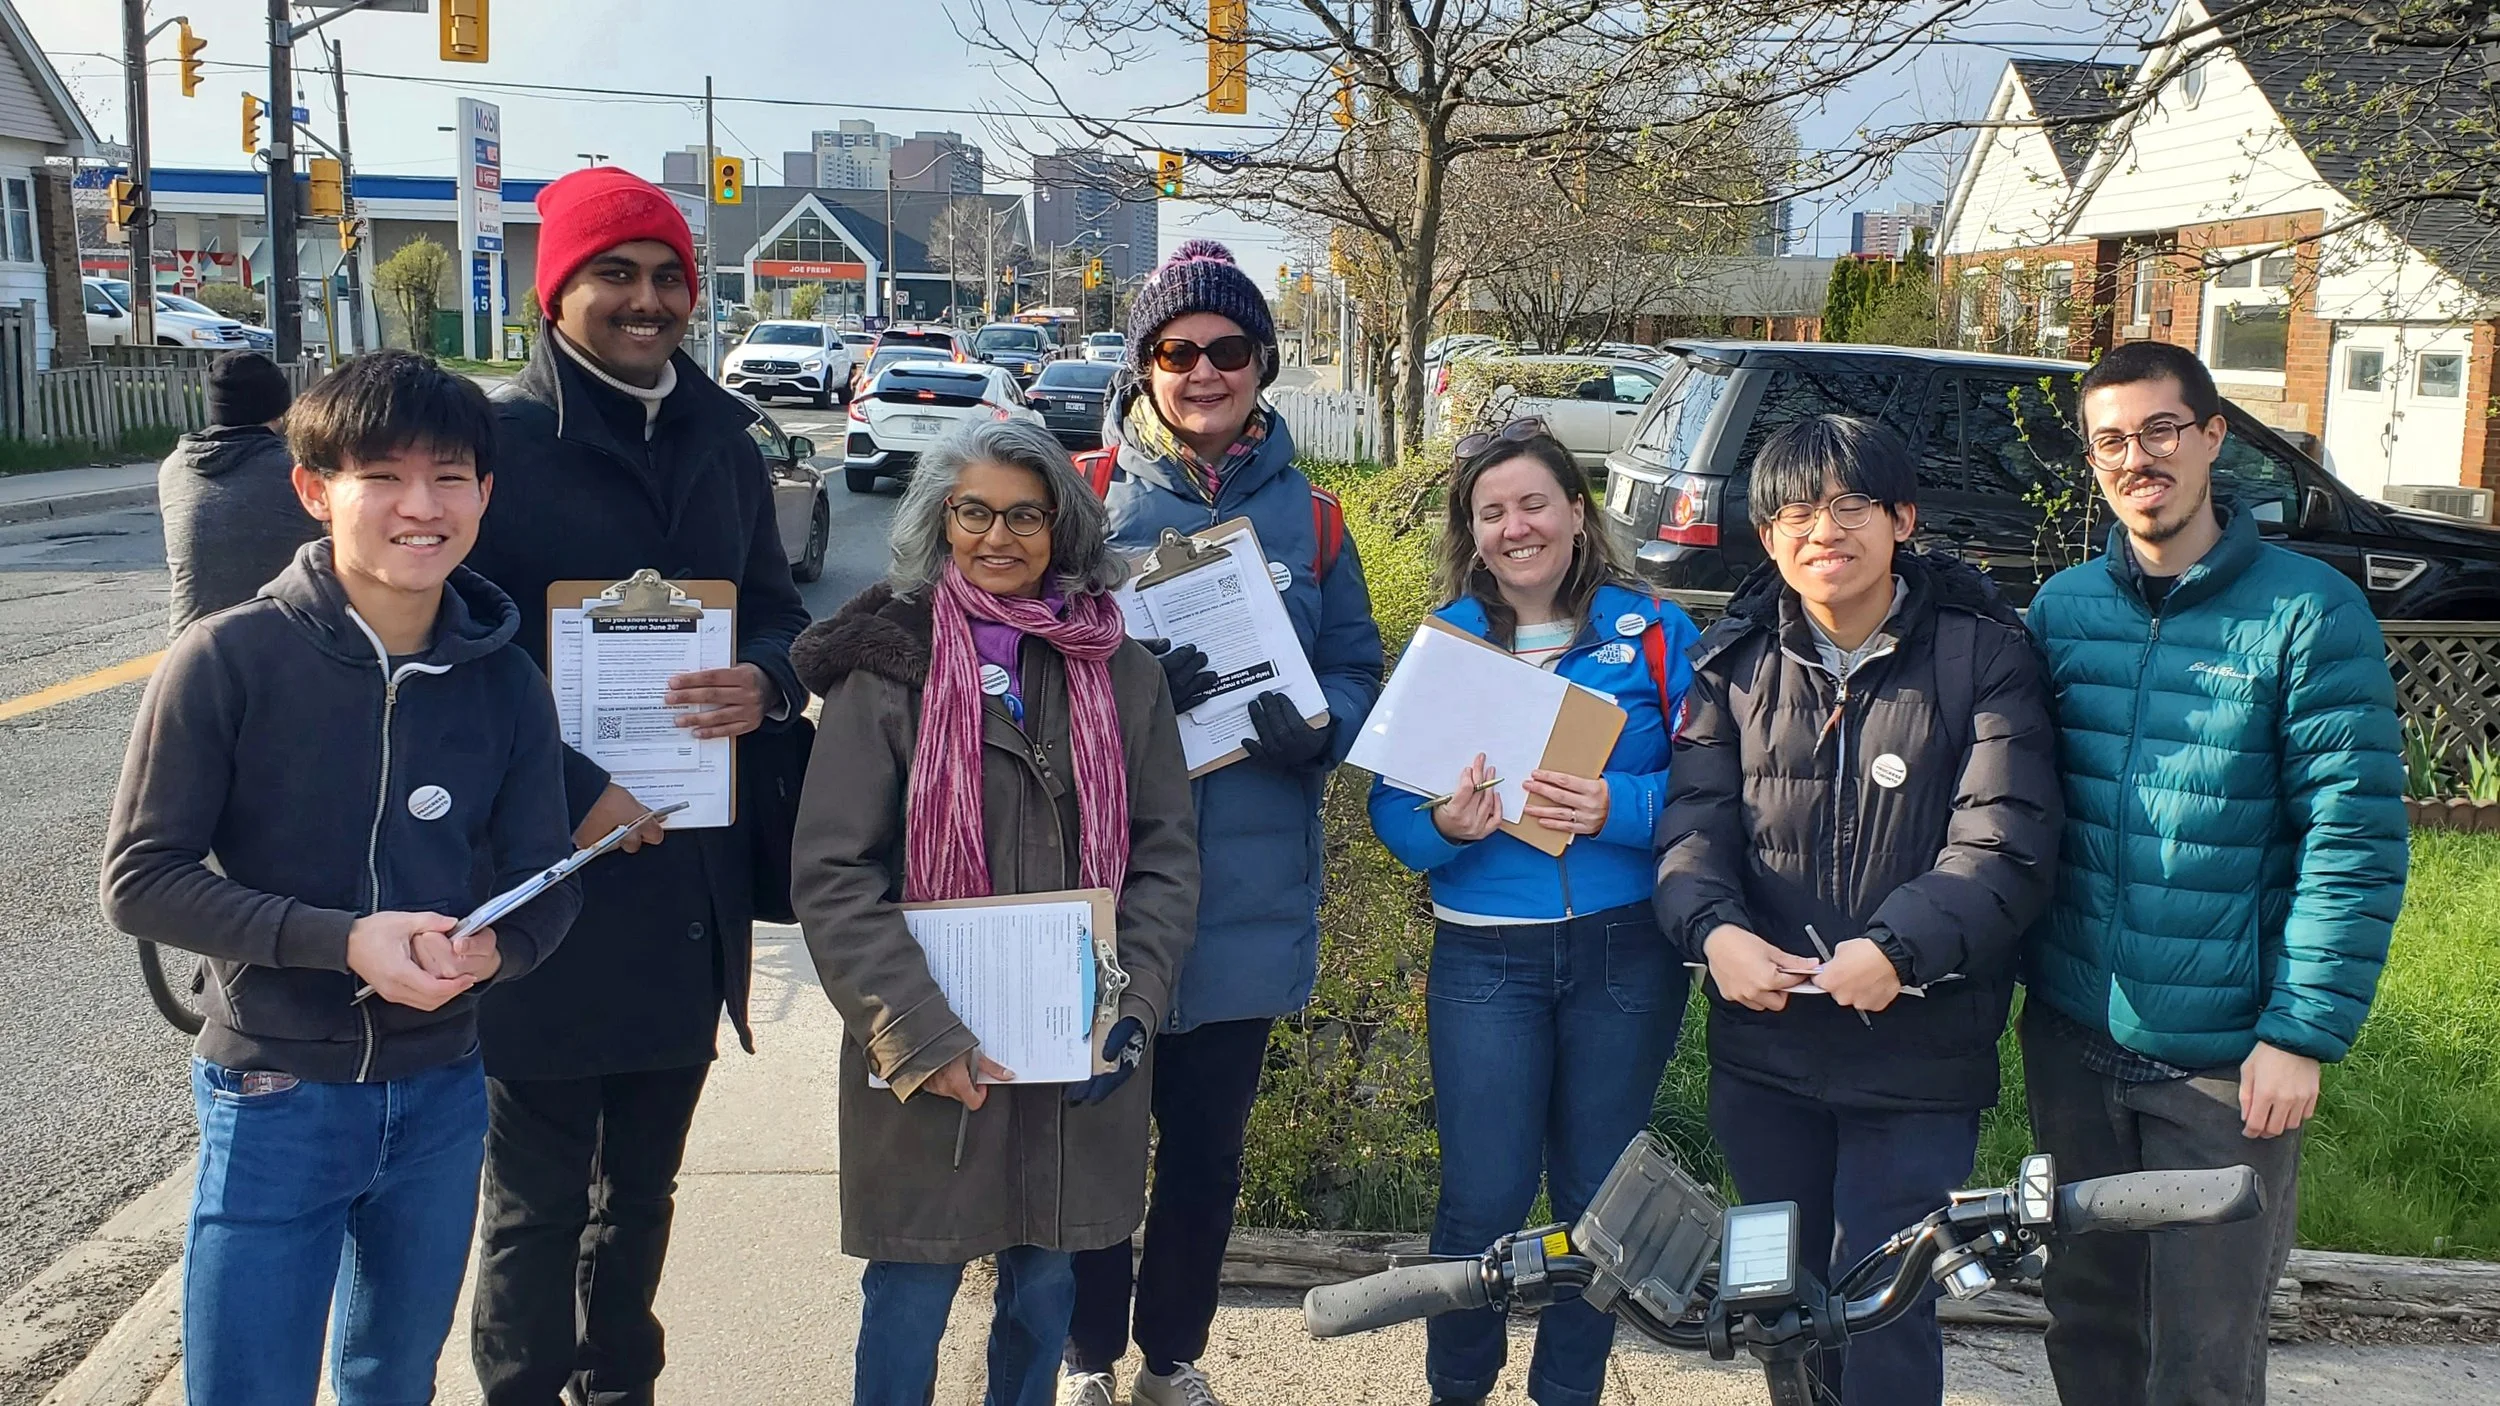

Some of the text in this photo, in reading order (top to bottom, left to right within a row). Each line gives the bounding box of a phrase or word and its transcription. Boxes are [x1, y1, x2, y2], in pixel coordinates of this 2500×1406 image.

[475, 107, 498, 133] Mobil
[806, 266, 831, 274] FRESH
[1588, 650, 1620, 658] NORTH
[416, 795, 446, 815] PROGRESS
[422, 799, 449, 817] TORONTO
